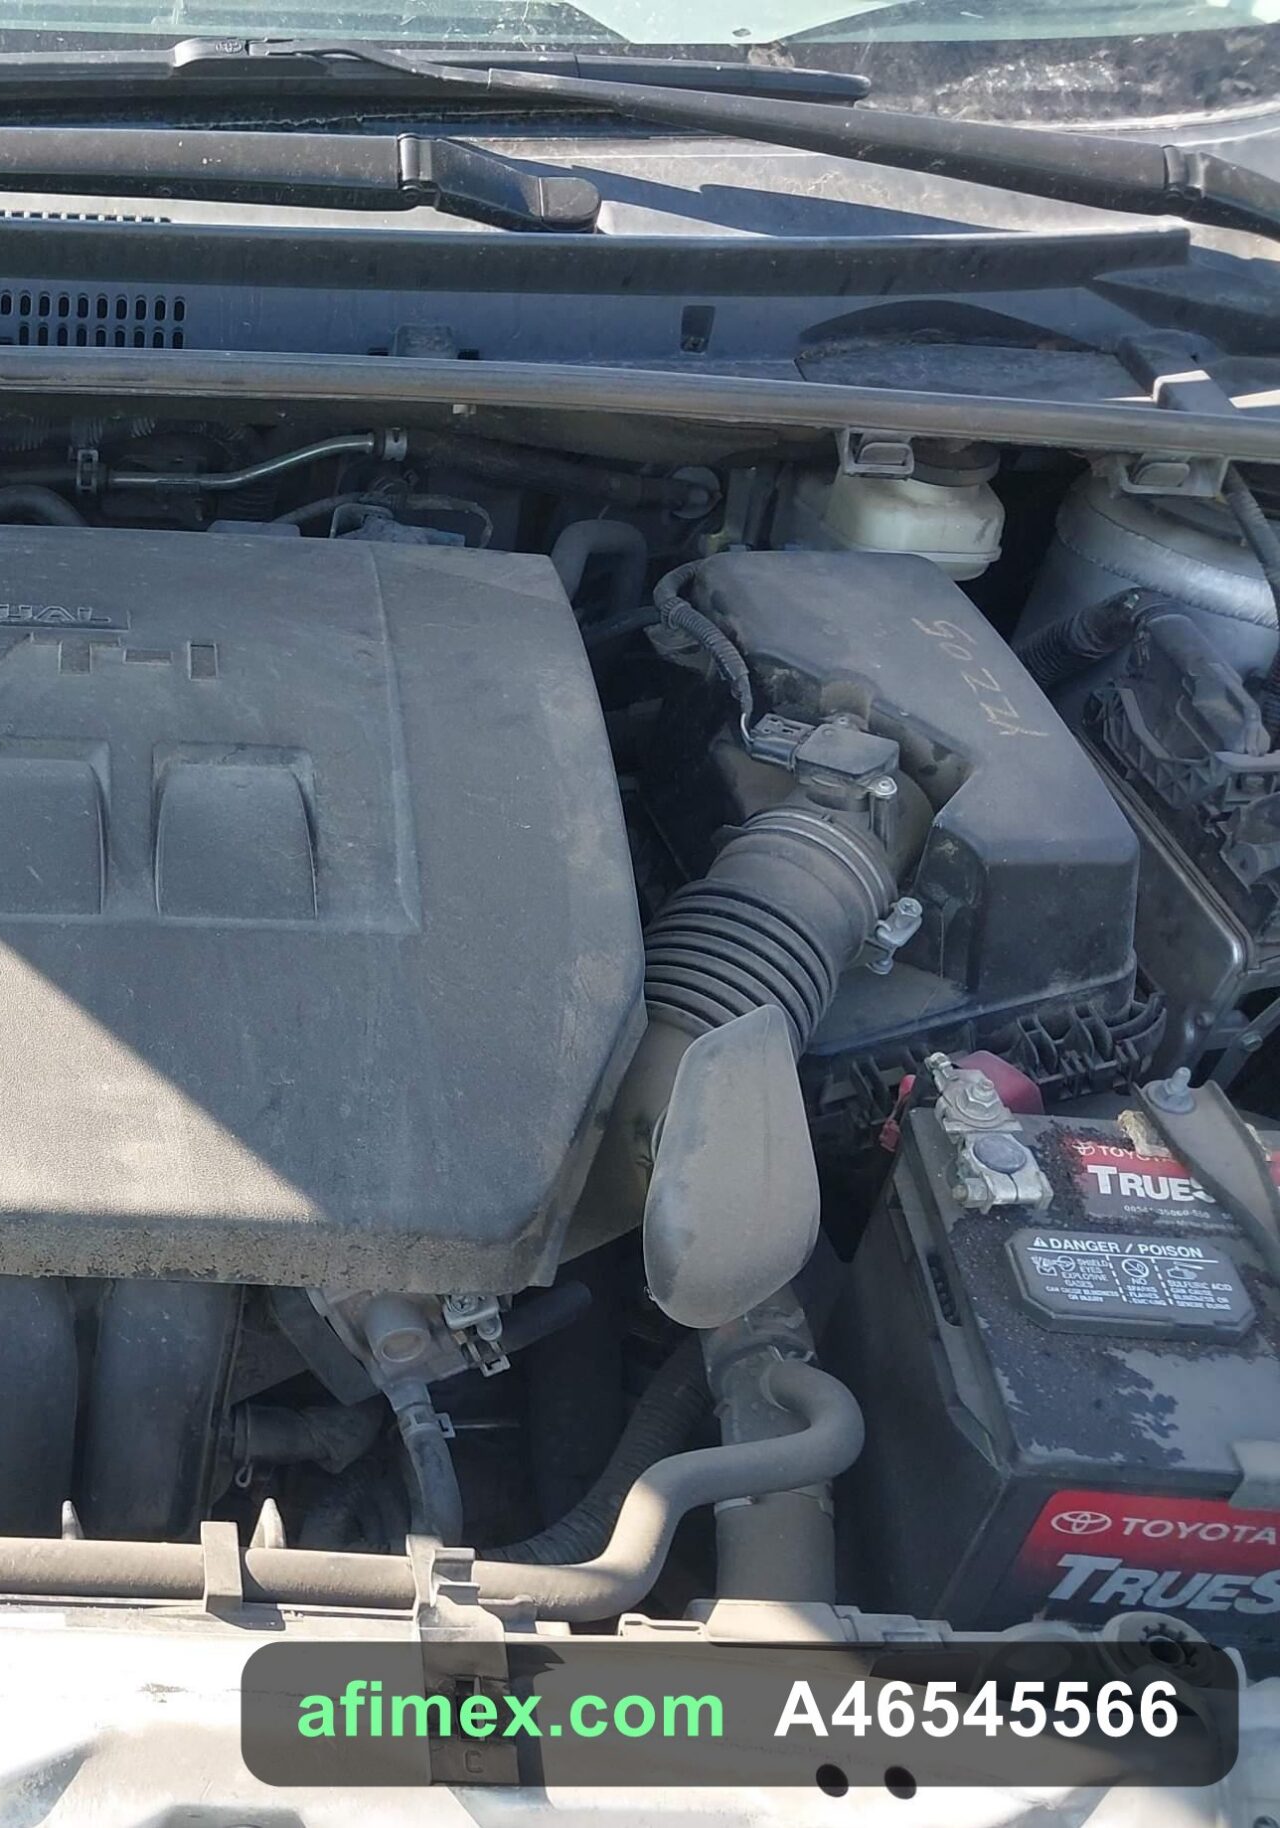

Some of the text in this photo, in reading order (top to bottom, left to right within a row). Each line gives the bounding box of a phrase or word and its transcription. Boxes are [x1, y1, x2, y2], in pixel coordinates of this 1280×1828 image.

[1048, 1237, 1121, 1254] DANGER
[1136, 1243, 1204, 1259] POISON
[1131, 1278, 1147, 1286] NO
[1121, 1516, 1277, 1546] TOYOTA
